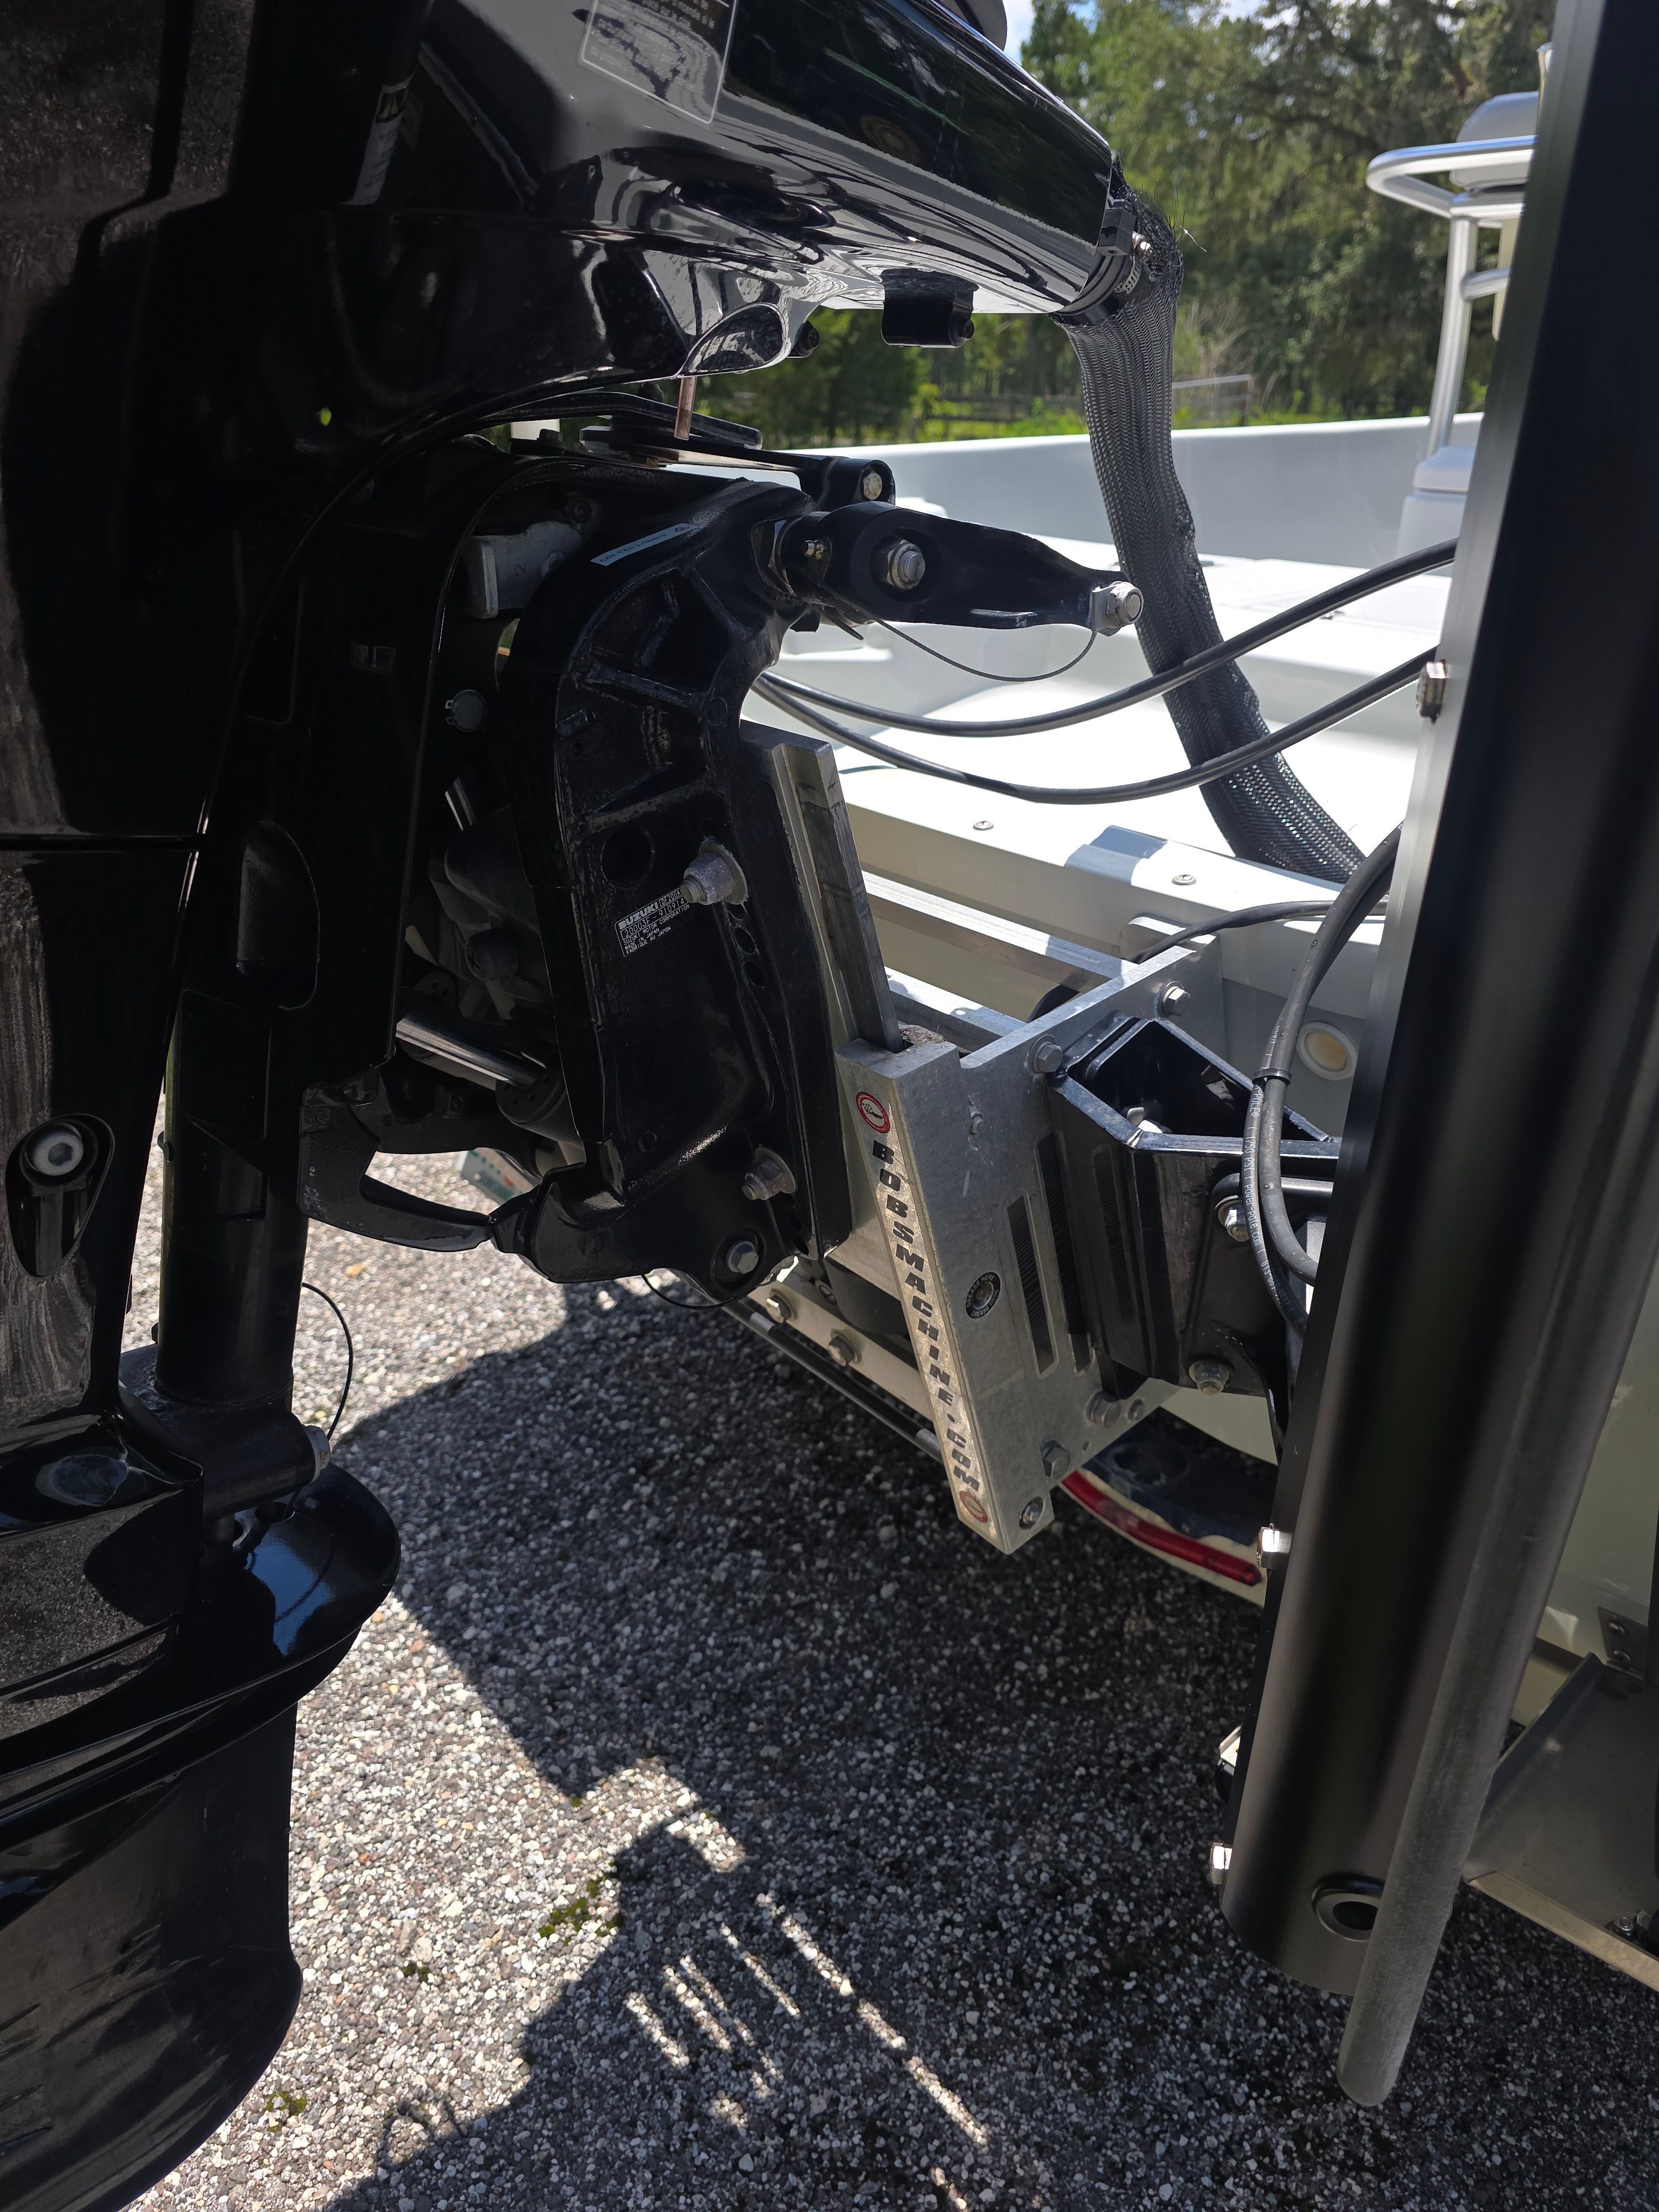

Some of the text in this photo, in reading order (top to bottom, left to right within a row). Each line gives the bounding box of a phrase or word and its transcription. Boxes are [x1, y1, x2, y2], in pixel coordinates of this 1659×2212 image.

[618, 890, 681, 930] SUZUKI DF200A
[624, 917, 650, 937] 20003F
[659, 897, 685, 916] 910914
[624, 904, 690, 946] SUZUKI MOTOR CORPORATION
[625, 941, 636, 951] MADE
[646, 927, 660, 938] JAPAN
[626, 940, 648, 955] FABRIQUE
[658, 925, 671, 937] JAPON
[1244, 1135, 1256, 1154] 1750
[1244, 1157, 1255, 1171] PSI
[966, 1274, 995, 1308] GREASE HERE
[872, 1139, 980, 1492] BOBSMACHINE.COM
[971, 1306, 990, 1318] GREASE
